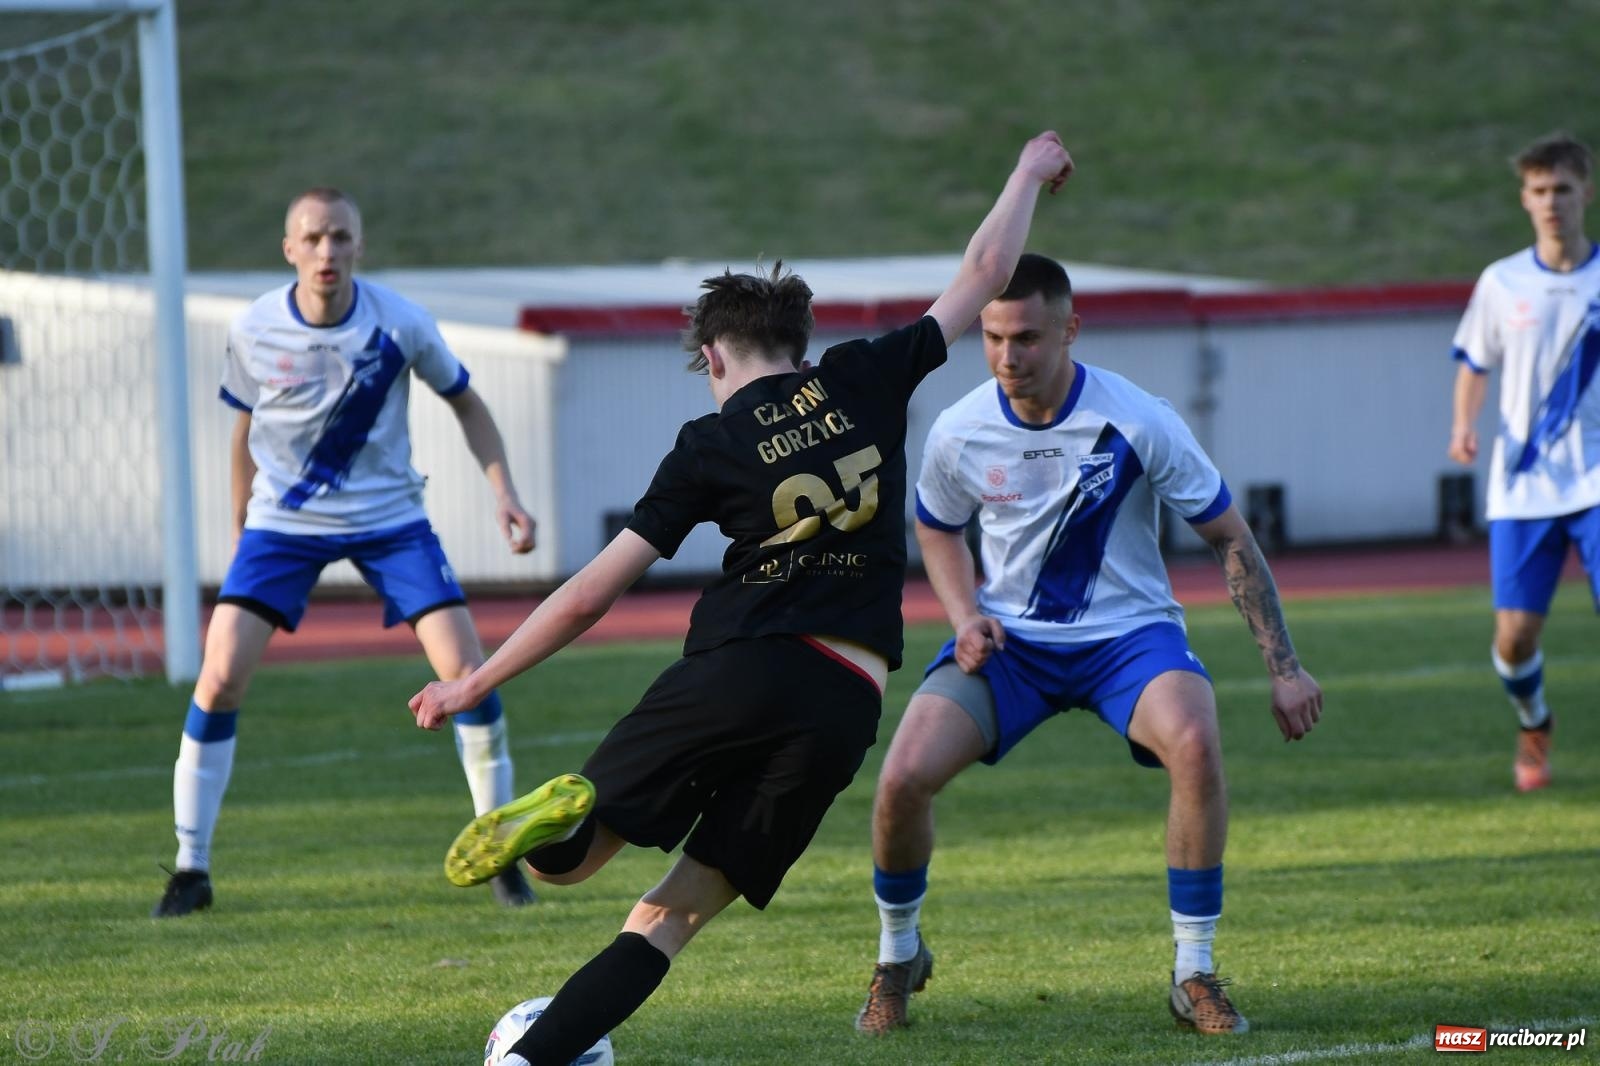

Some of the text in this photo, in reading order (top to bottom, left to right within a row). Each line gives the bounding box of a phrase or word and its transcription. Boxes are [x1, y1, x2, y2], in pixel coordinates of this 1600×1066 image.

[753, 377, 829, 427] CZARNI
[757, 408, 856, 464] GORZYCE
[760, 444, 882, 548] 25
[1082, 470, 1111, 490] UNIA
[798, 552, 868, 568] CINIC
